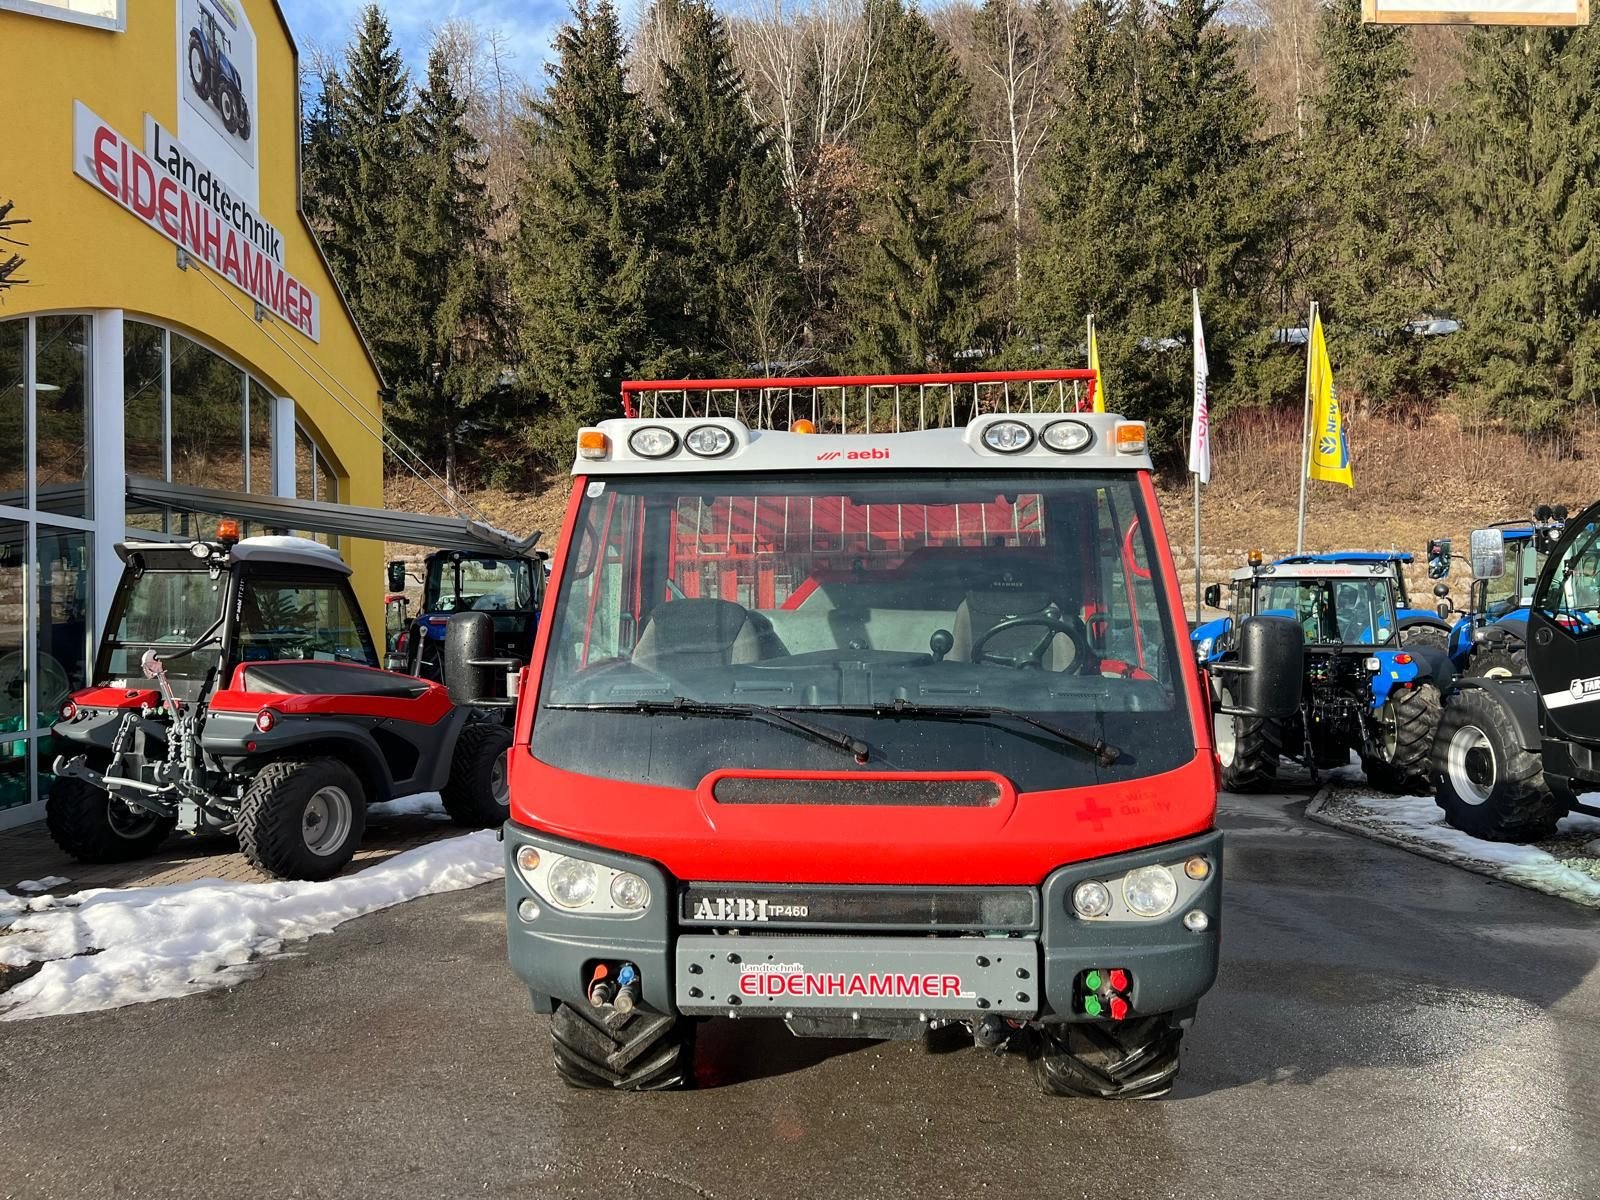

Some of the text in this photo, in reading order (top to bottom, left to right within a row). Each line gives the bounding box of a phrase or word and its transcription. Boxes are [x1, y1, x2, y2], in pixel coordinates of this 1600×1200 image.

[154, 122, 280, 263] Landtechnik
[93, 125, 313, 336] EIDENHAMMER
[847, 448, 890, 460] aebi
[1119, 799, 1171, 815] Quity
[693, 897, 809, 922] AEBI TP460
[740, 962, 804, 973] Landtechnik
[739, 973, 962, 997] EIDENHAMMER
